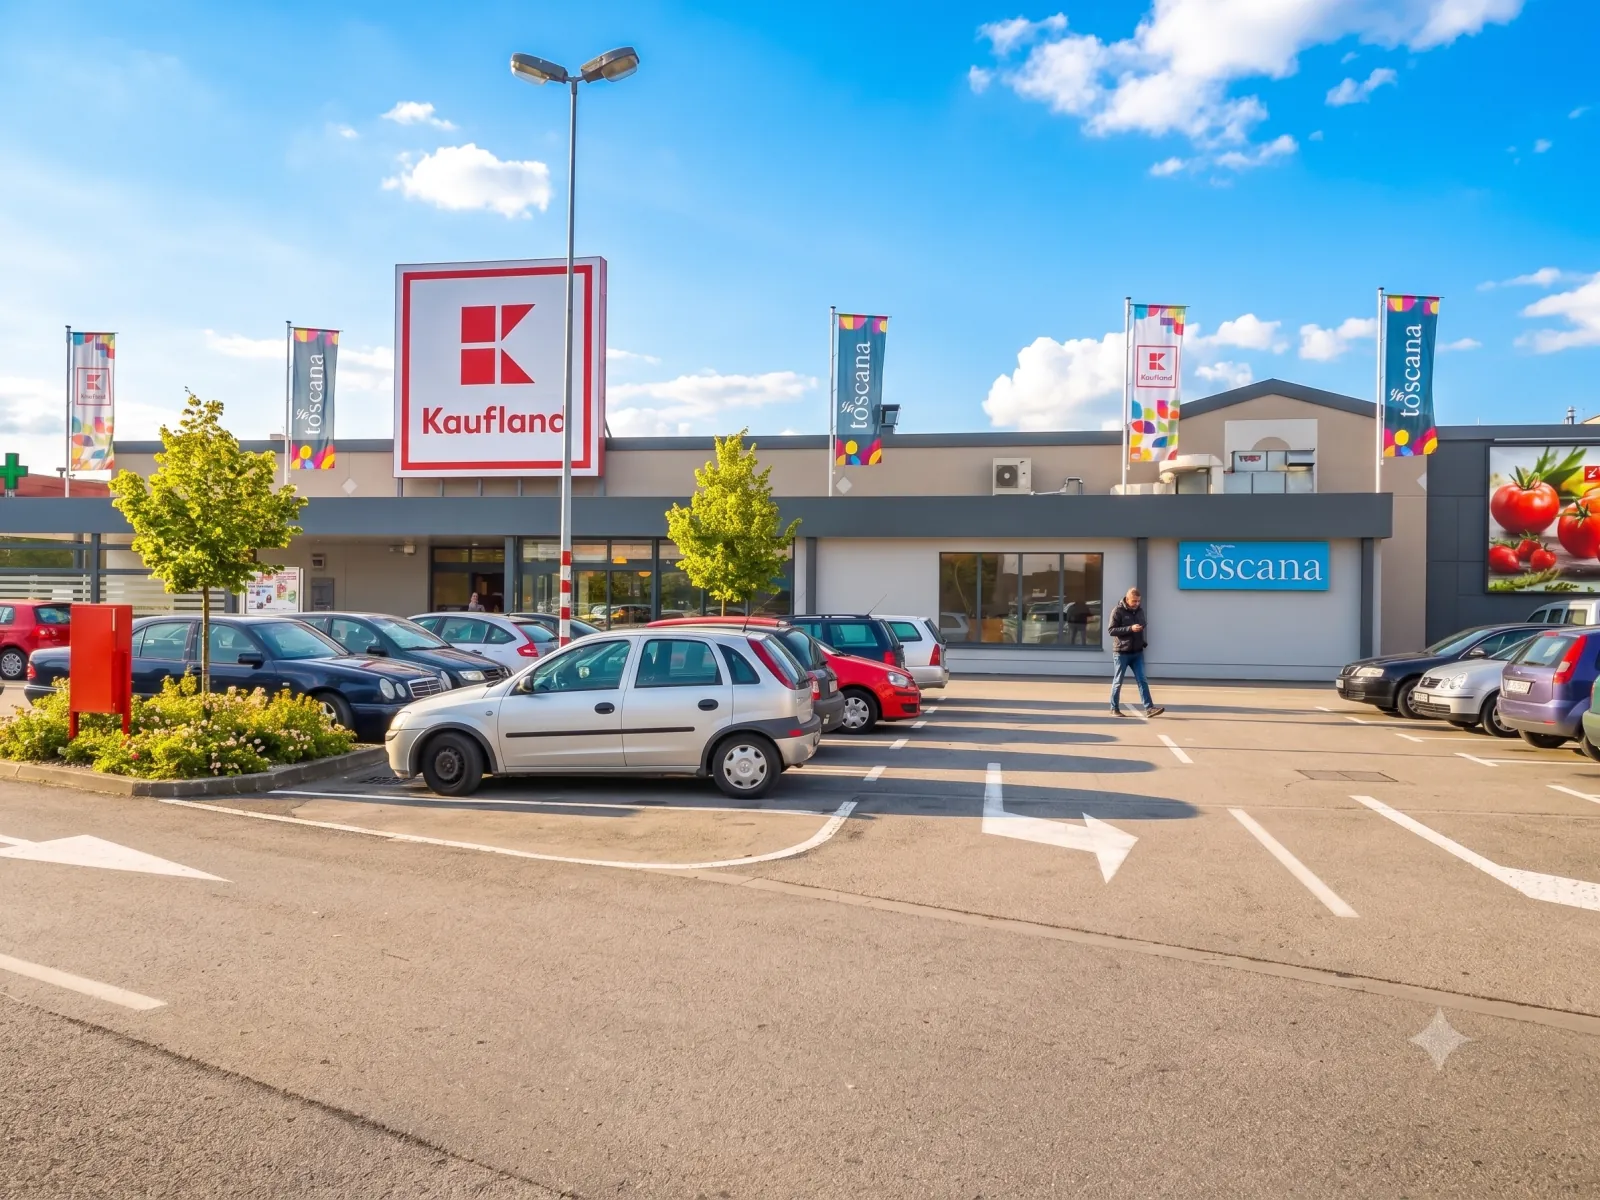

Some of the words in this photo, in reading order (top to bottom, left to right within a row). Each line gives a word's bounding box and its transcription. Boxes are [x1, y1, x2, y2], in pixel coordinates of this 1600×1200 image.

[305, 353, 324, 435] toscana
[850, 341, 871, 429] toscana
[1400, 324, 1422, 417] toscana
[422, 405, 565, 434] Kaufland
[1183, 554, 1323, 581] toscana
